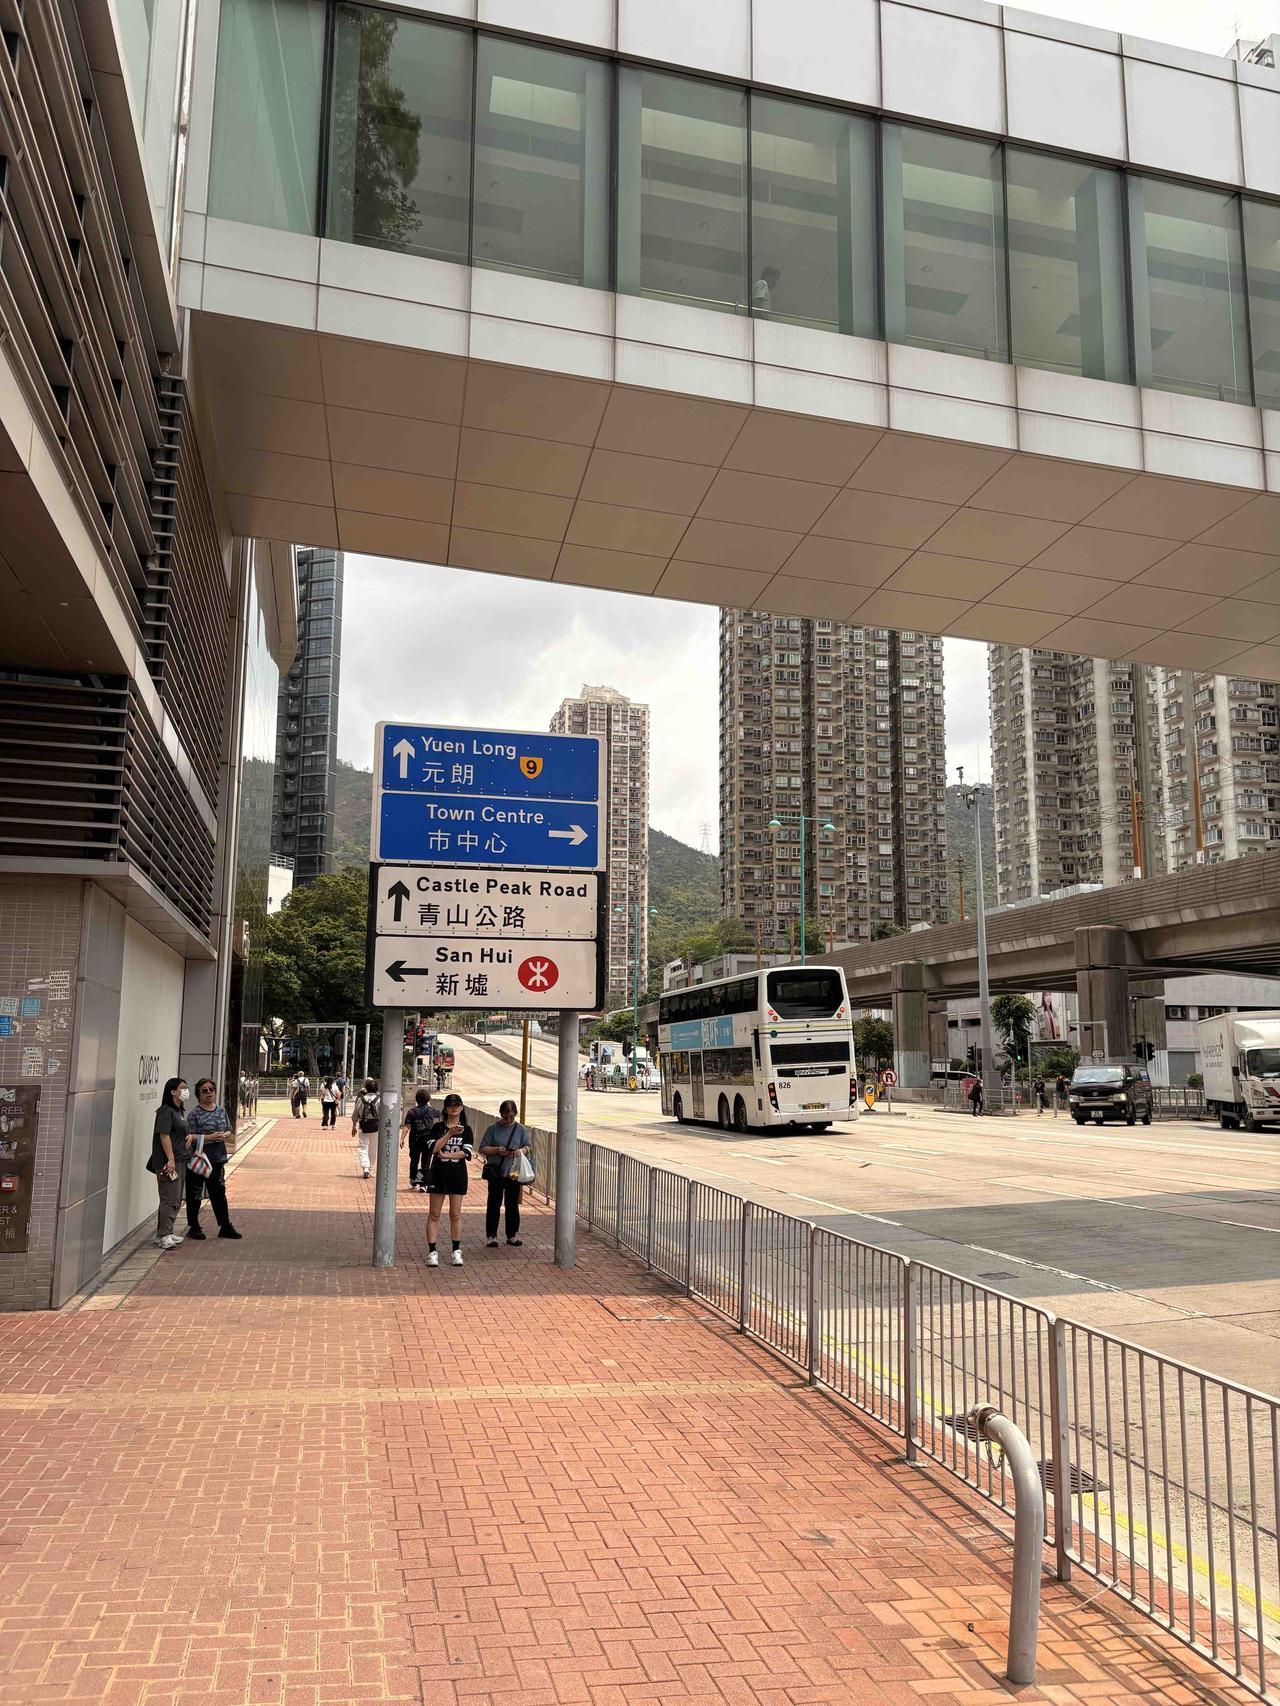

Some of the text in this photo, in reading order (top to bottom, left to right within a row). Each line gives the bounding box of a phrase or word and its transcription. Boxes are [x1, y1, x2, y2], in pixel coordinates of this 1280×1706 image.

[421, 736, 517, 759] Yuen Long
[421, 761, 475, 785] 元朗
[525, 759, 538, 774] 9
[426, 803, 544, 824] Town Centre
[427, 830, 508, 854] 市中心
[416, 876, 588, 898] Castle Peak Road
[417, 903, 526, 929] 青山公路
[435, 946, 513, 964] San Hui
[435, 973, 489, 997] 新墟
[778, 1081, 792, 1089] 826
[1, 1106, 25, 1115] REEL
[11, 1205, 18, 1214] &
